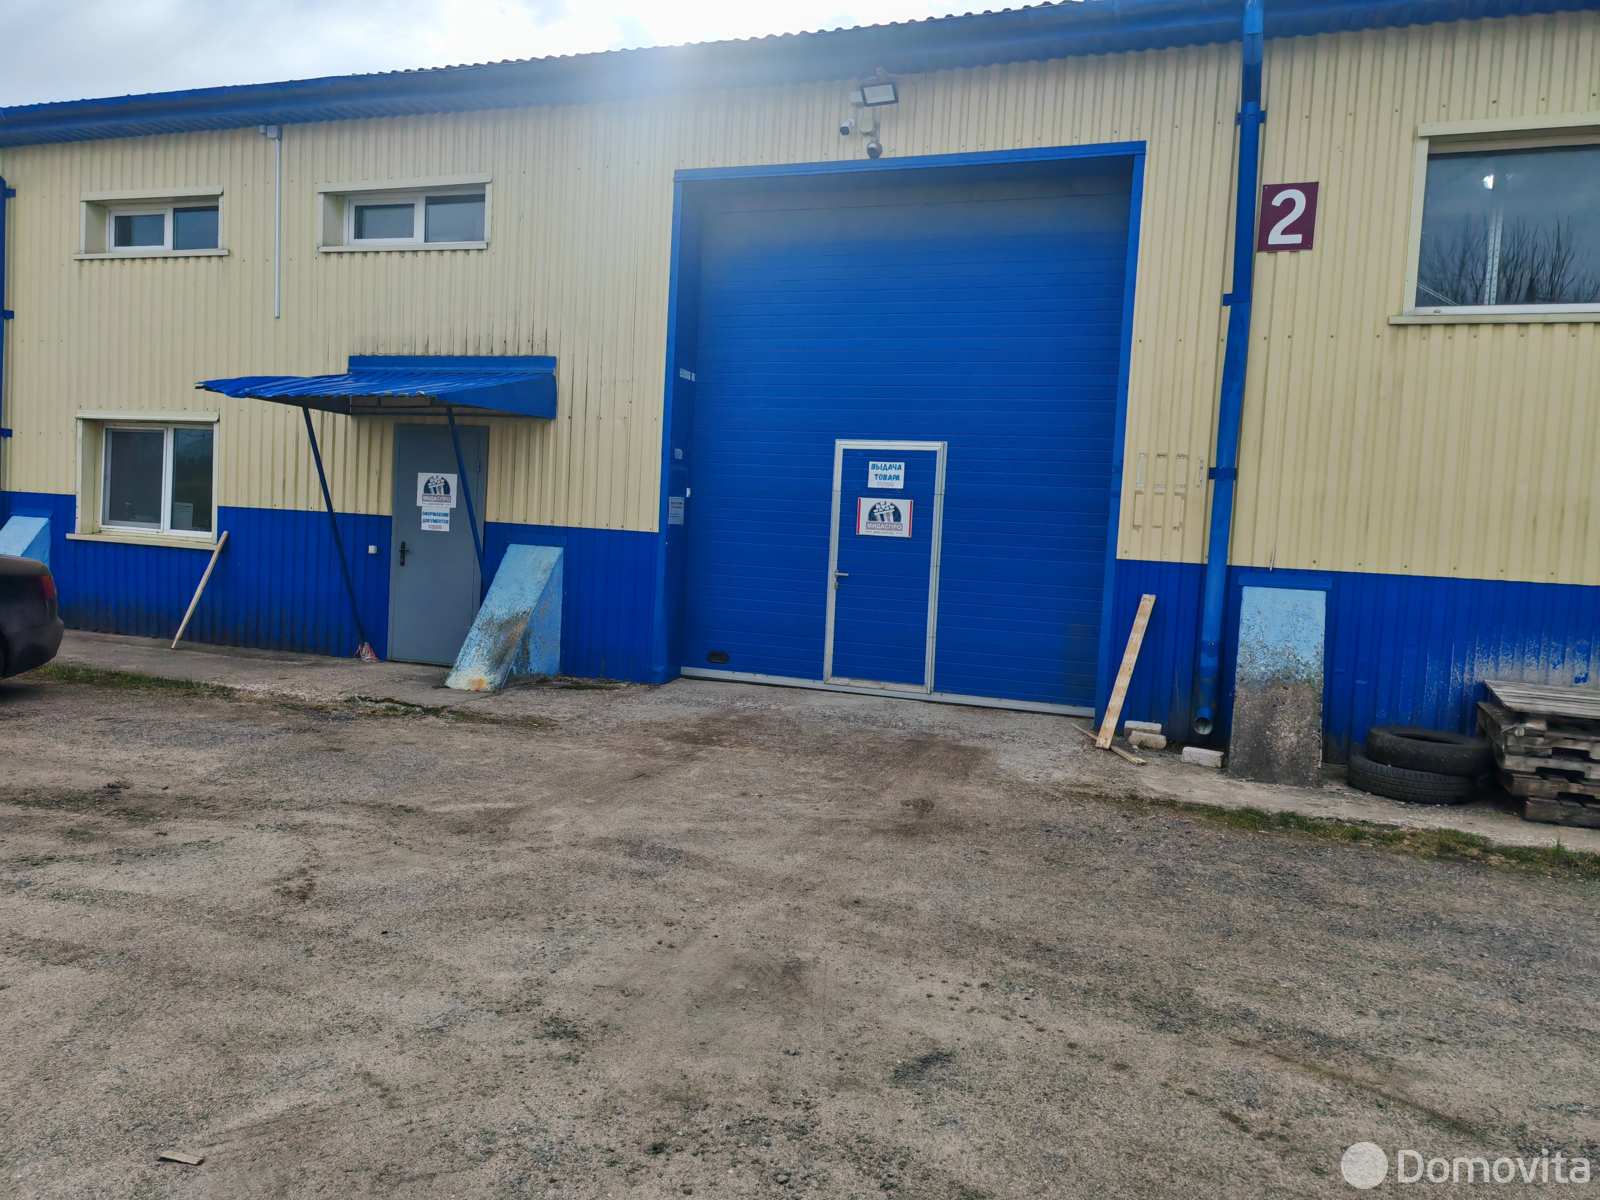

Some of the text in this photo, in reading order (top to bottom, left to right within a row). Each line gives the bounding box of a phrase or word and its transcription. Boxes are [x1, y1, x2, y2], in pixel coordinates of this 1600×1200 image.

[1268, 189, 1306, 245] 2
[871, 463, 902, 471] ВЫДАЧА
[874, 473, 900, 481] ТОВАРА
[867, 522, 902, 530] МИДАСПРО
